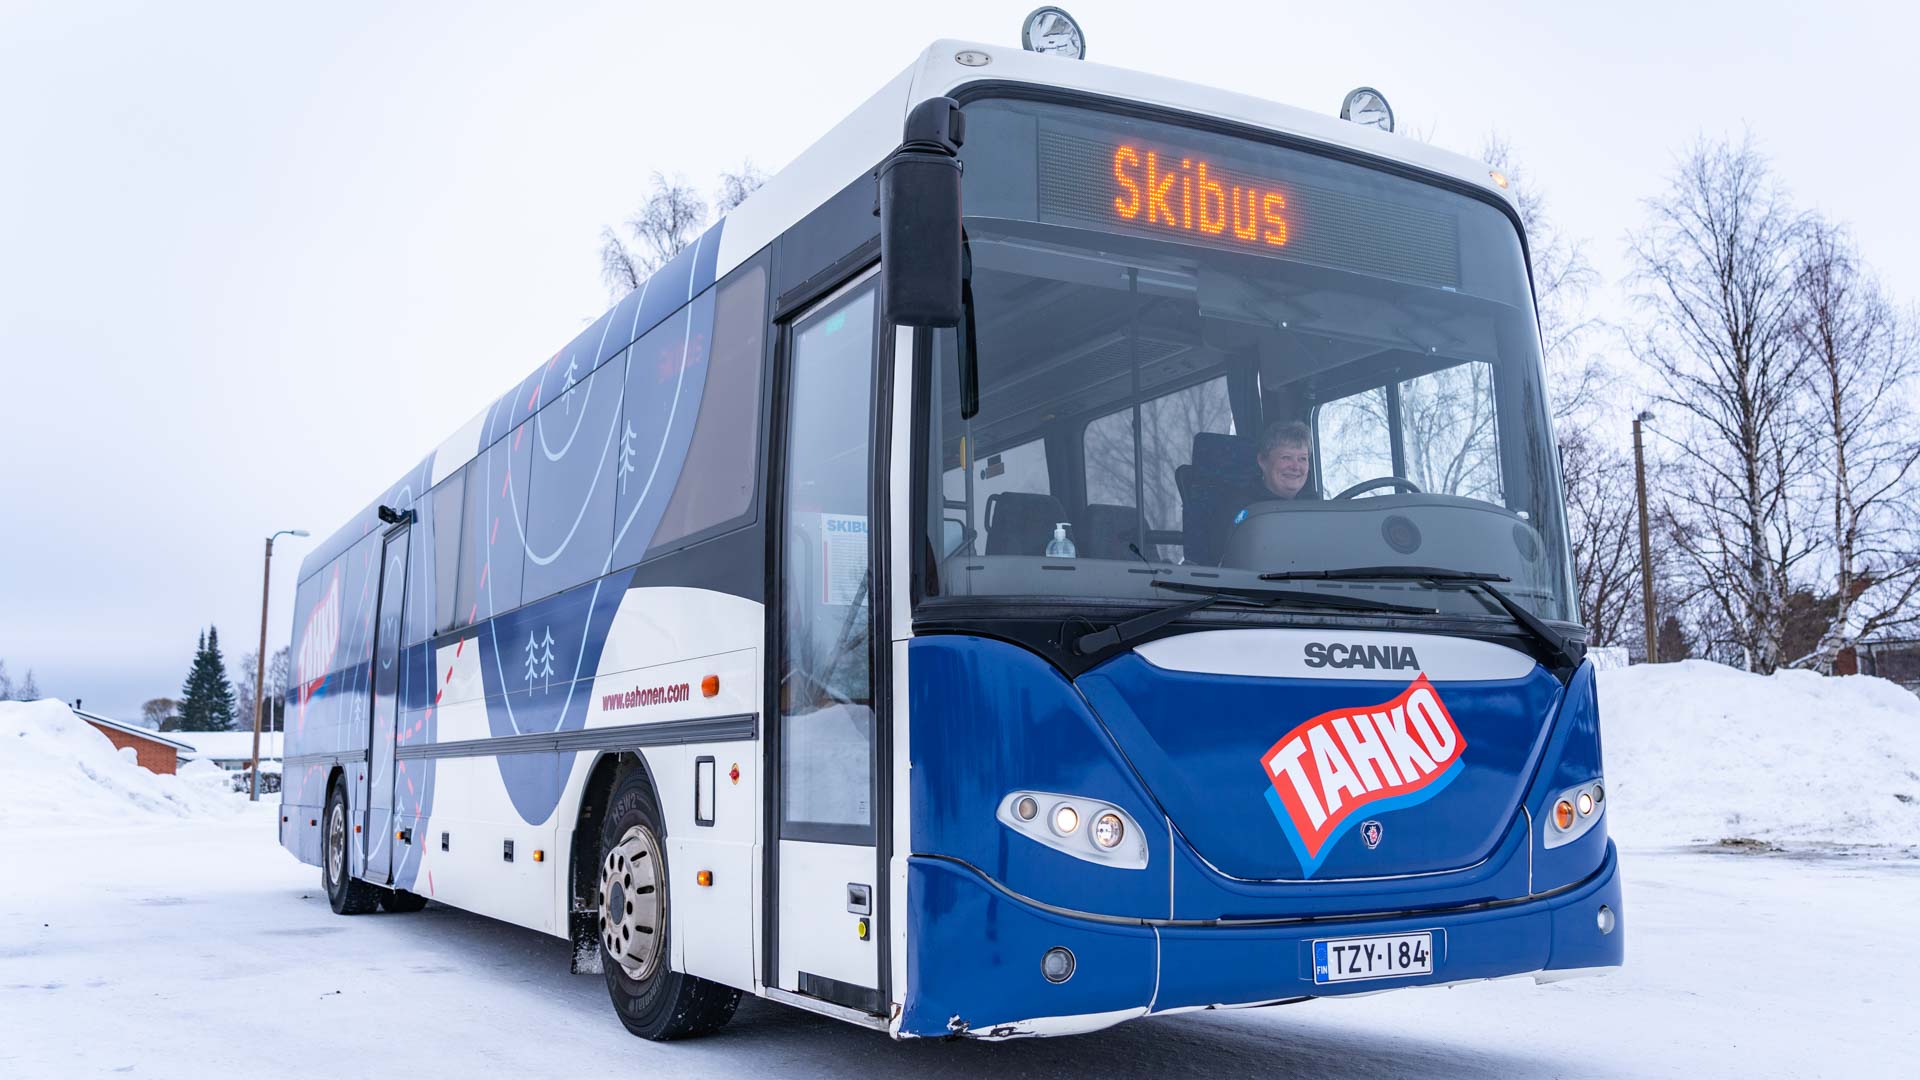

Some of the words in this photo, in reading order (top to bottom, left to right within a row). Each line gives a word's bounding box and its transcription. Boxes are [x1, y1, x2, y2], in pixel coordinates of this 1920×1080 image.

[1115, 145, 1287, 246] Skibus
[1303, 642, 1421, 671] SCANIA
[602, 682, 690, 711] www.eahonen.com
[1268, 688, 1457, 832] TAHKO
[1317, 966, 1328, 975] FIN
[1332, 940, 1427, 975] TZY-184
